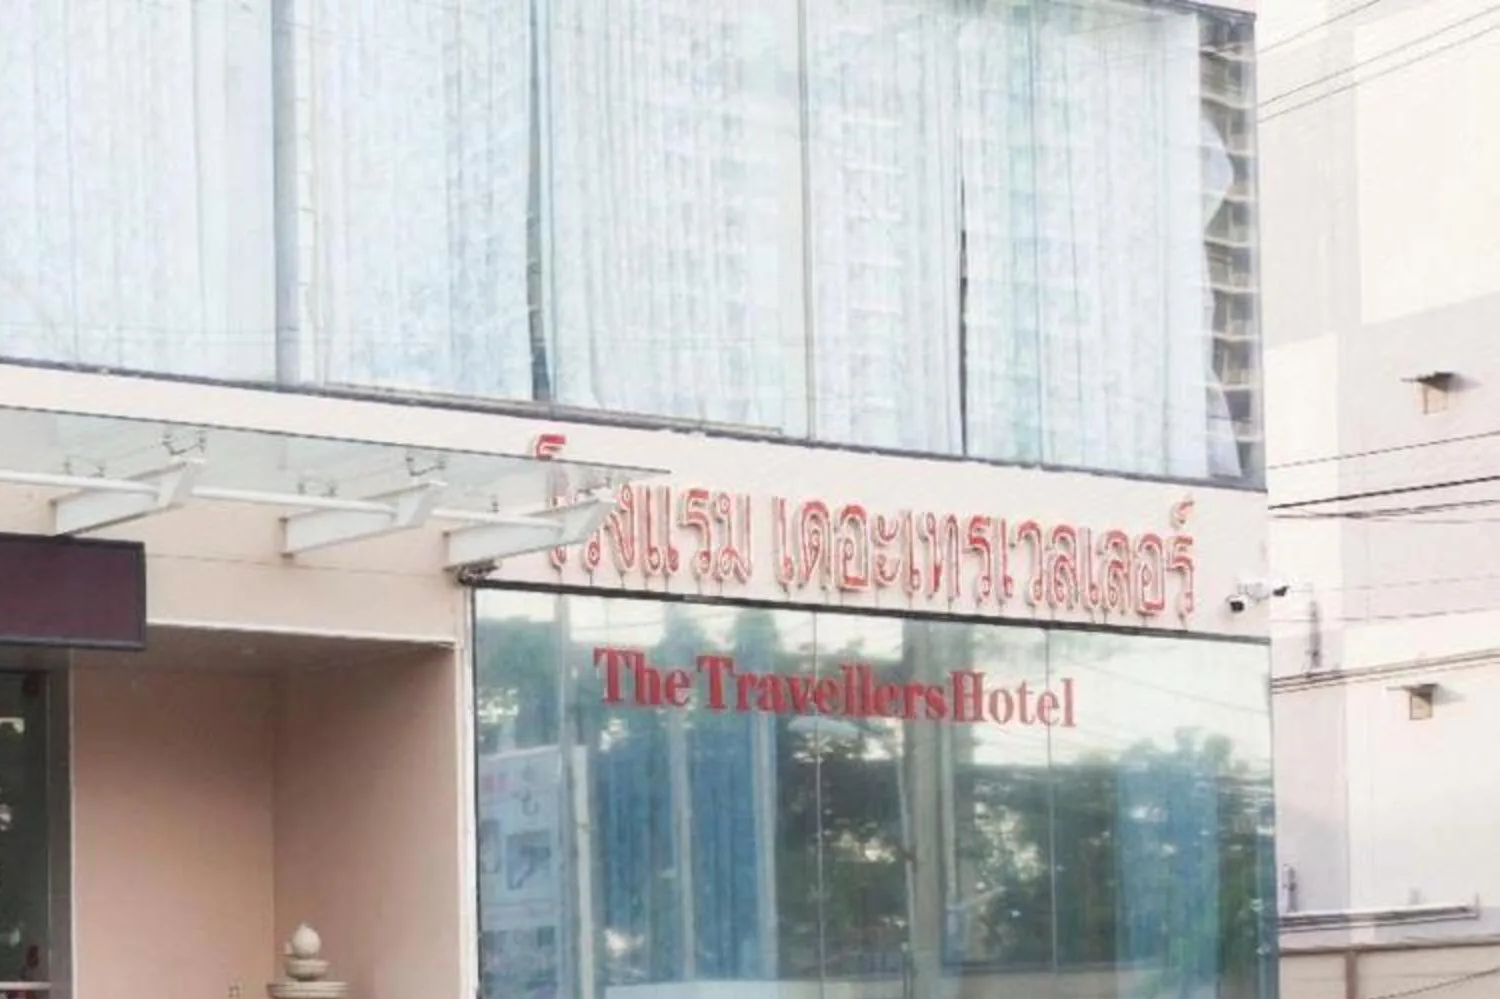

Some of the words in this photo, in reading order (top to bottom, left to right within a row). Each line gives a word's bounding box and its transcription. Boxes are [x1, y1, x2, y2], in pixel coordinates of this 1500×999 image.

[593, 645, 693, 710] The
[696, 654, 951, 723] Travellers
[950, 667, 1078, 729] Hotel
